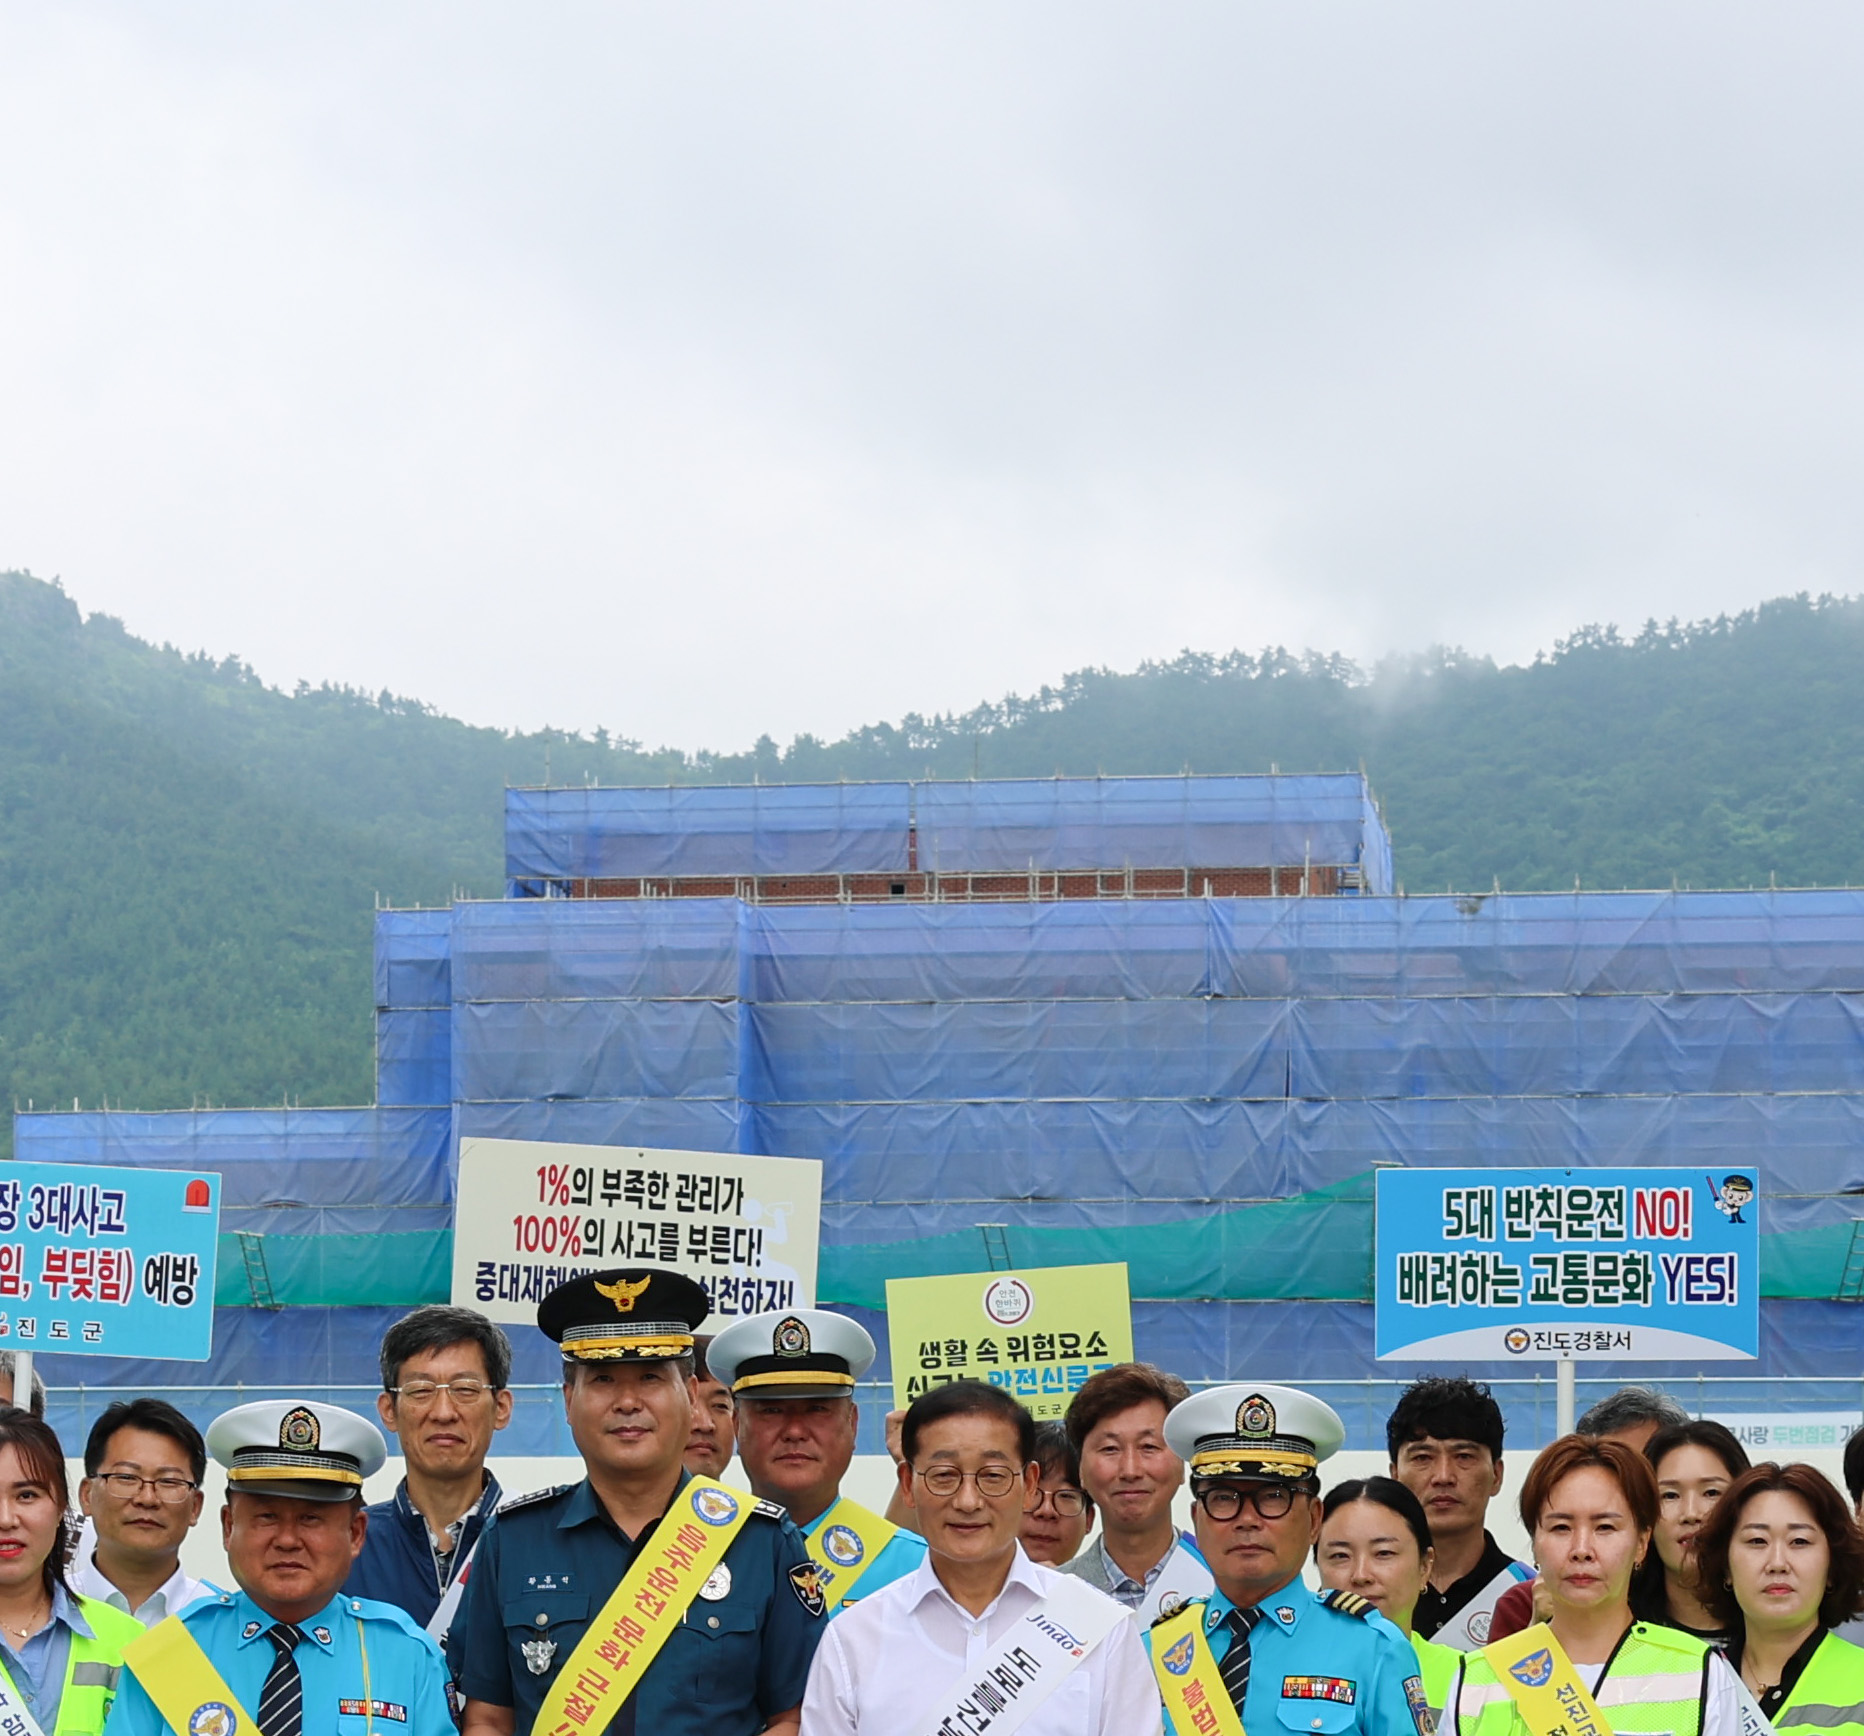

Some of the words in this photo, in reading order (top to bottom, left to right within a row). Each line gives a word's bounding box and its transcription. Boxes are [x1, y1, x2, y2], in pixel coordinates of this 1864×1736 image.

[28, 1184, 126, 1236] 3대사고
[536, 1164, 594, 1207] 1%의
[600, 1168, 669, 1210] 부족한
[675, 1174, 744, 1216] 관리가
[1446, 1188, 1494, 1239] 5대
[1505, 1186, 1624, 1239] 반칙운전
[1636, 1190, 1689, 1238] NO!
[513, 1215, 605, 1257] 100%의
[611, 1219, 679, 1262] 사고를
[687, 1225, 763, 1267] 부른다!
[41, 1248, 134, 1304] 부딪힘)
[144, 1253, 199, 1306] 예방
[1399, 1253, 1520, 1305] 배려하는
[1531, 1253, 1652, 1305] 교통문화
[1661, 1255, 1736, 1303] YES!
[919, 1338, 968, 1370] 생활
[976, 1338, 1000, 1366] 속
[1006, 1330, 1108, 1363] 위험요소
[1533, 1330, 1632, 1351] 진도경찰서
[1773, 1424, 1837, 1445] 두번점검
[634, 1523, 708, 1622] 음주운전
[595, 1615, 644, 1672] 문화
[1027, 1614, 1075, 1651] Jindo
